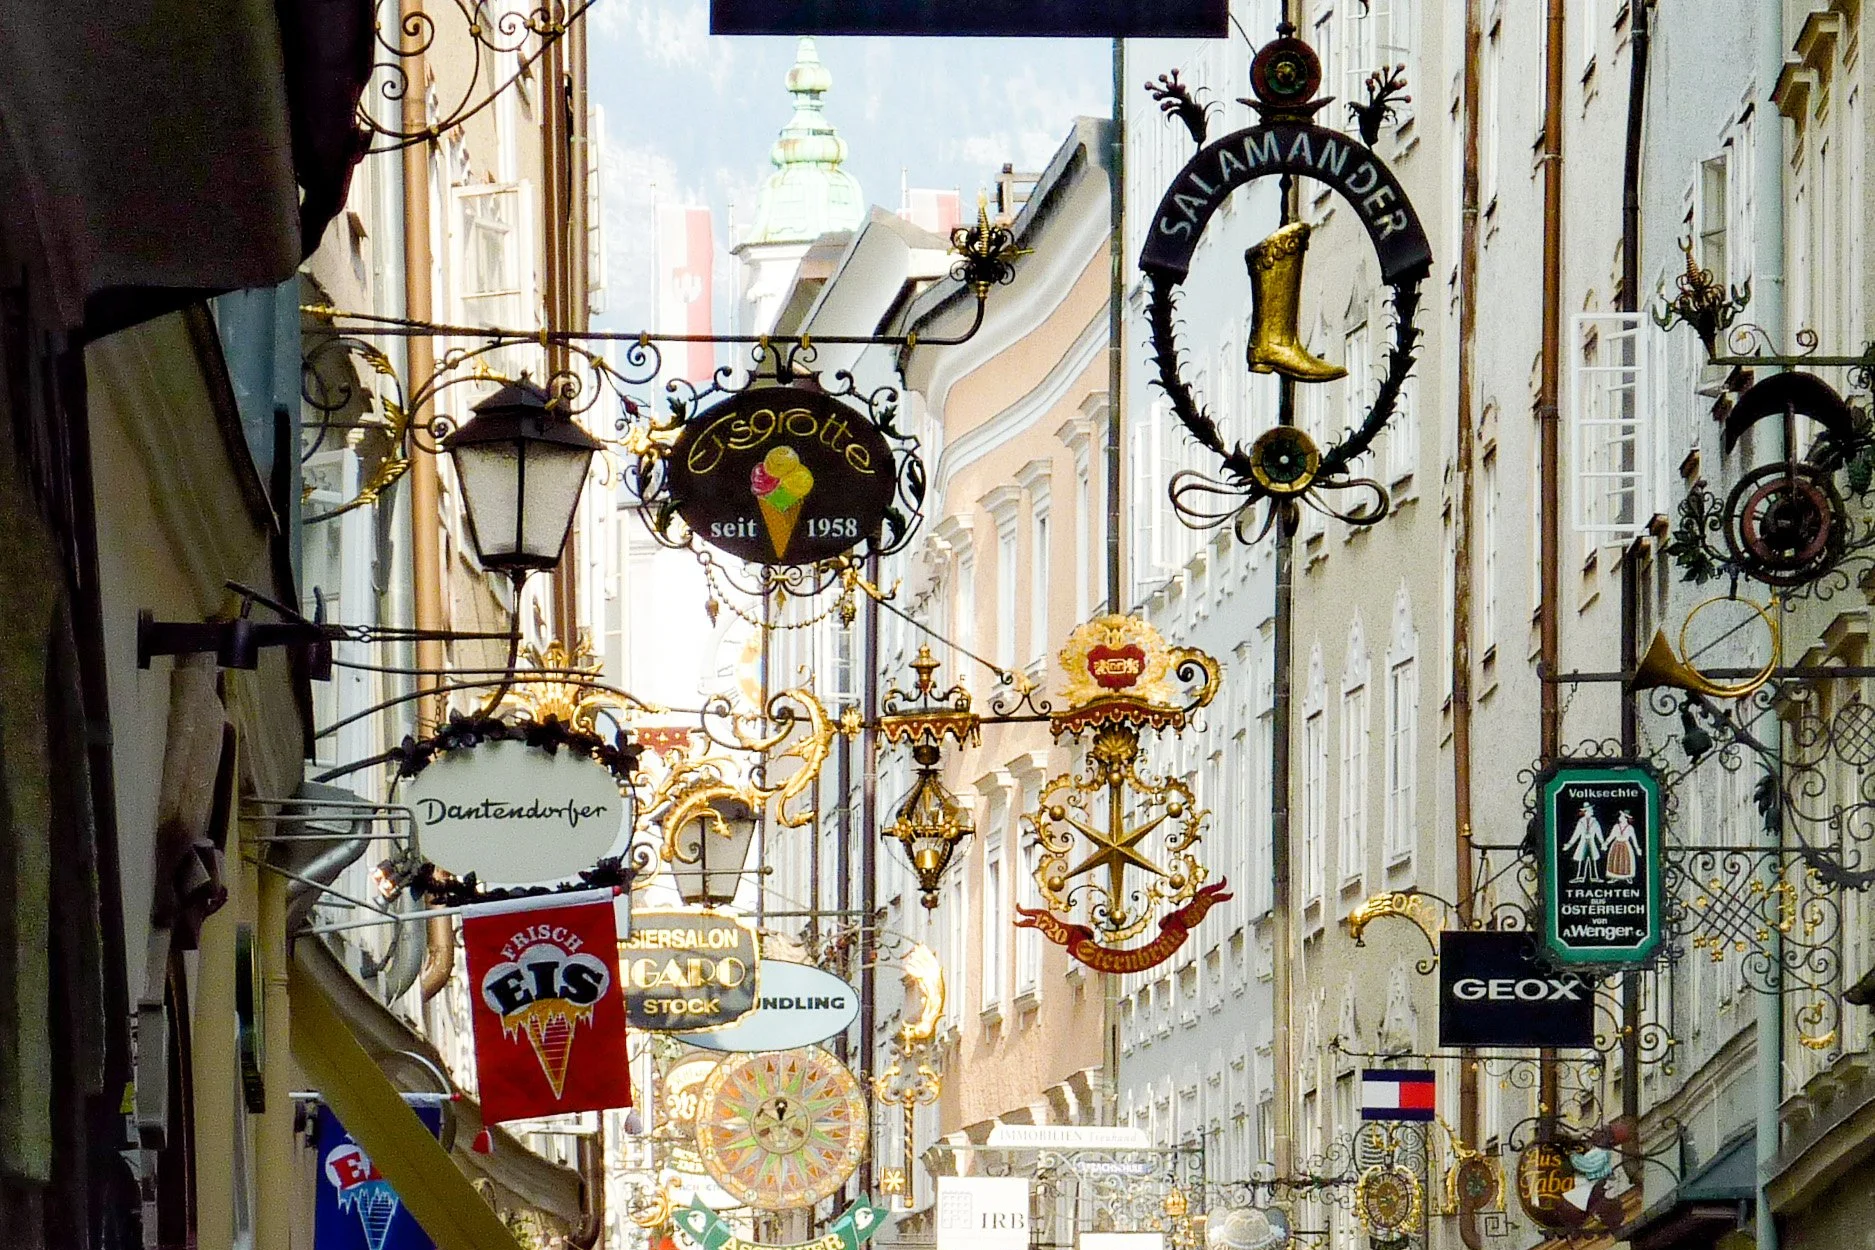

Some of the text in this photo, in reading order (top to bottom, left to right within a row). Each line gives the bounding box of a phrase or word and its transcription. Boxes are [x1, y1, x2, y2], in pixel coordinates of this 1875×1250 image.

[1159, 131, 1409, 240] SALAMANDER
[687, 406, 876, 473] Eisgrotte
[710, 516, 858, 538] seit 1958
[1568, 788, 1639, 799] Volksechte
[417, 797, 608, 829] Dantendorfer
[1565, 888, 1641, 899] TRACHTEN
[1561, 903, 1645, 916] ÖSTERREICH
[500, 923, 583, 960] FRISCH
[617, 928, 739, 949] SIERSALON
[619, 956, 746, 988] IGARO
[499, 960, 605, 1018] EIS
[1452, 977, 1582, 1001] GEOX
[643, 998, 720, 1015] STOCK
[1000, 1127, 1082, 1142] IMMOBILIEN
[981, 1212, 1026, 1230] IRB
